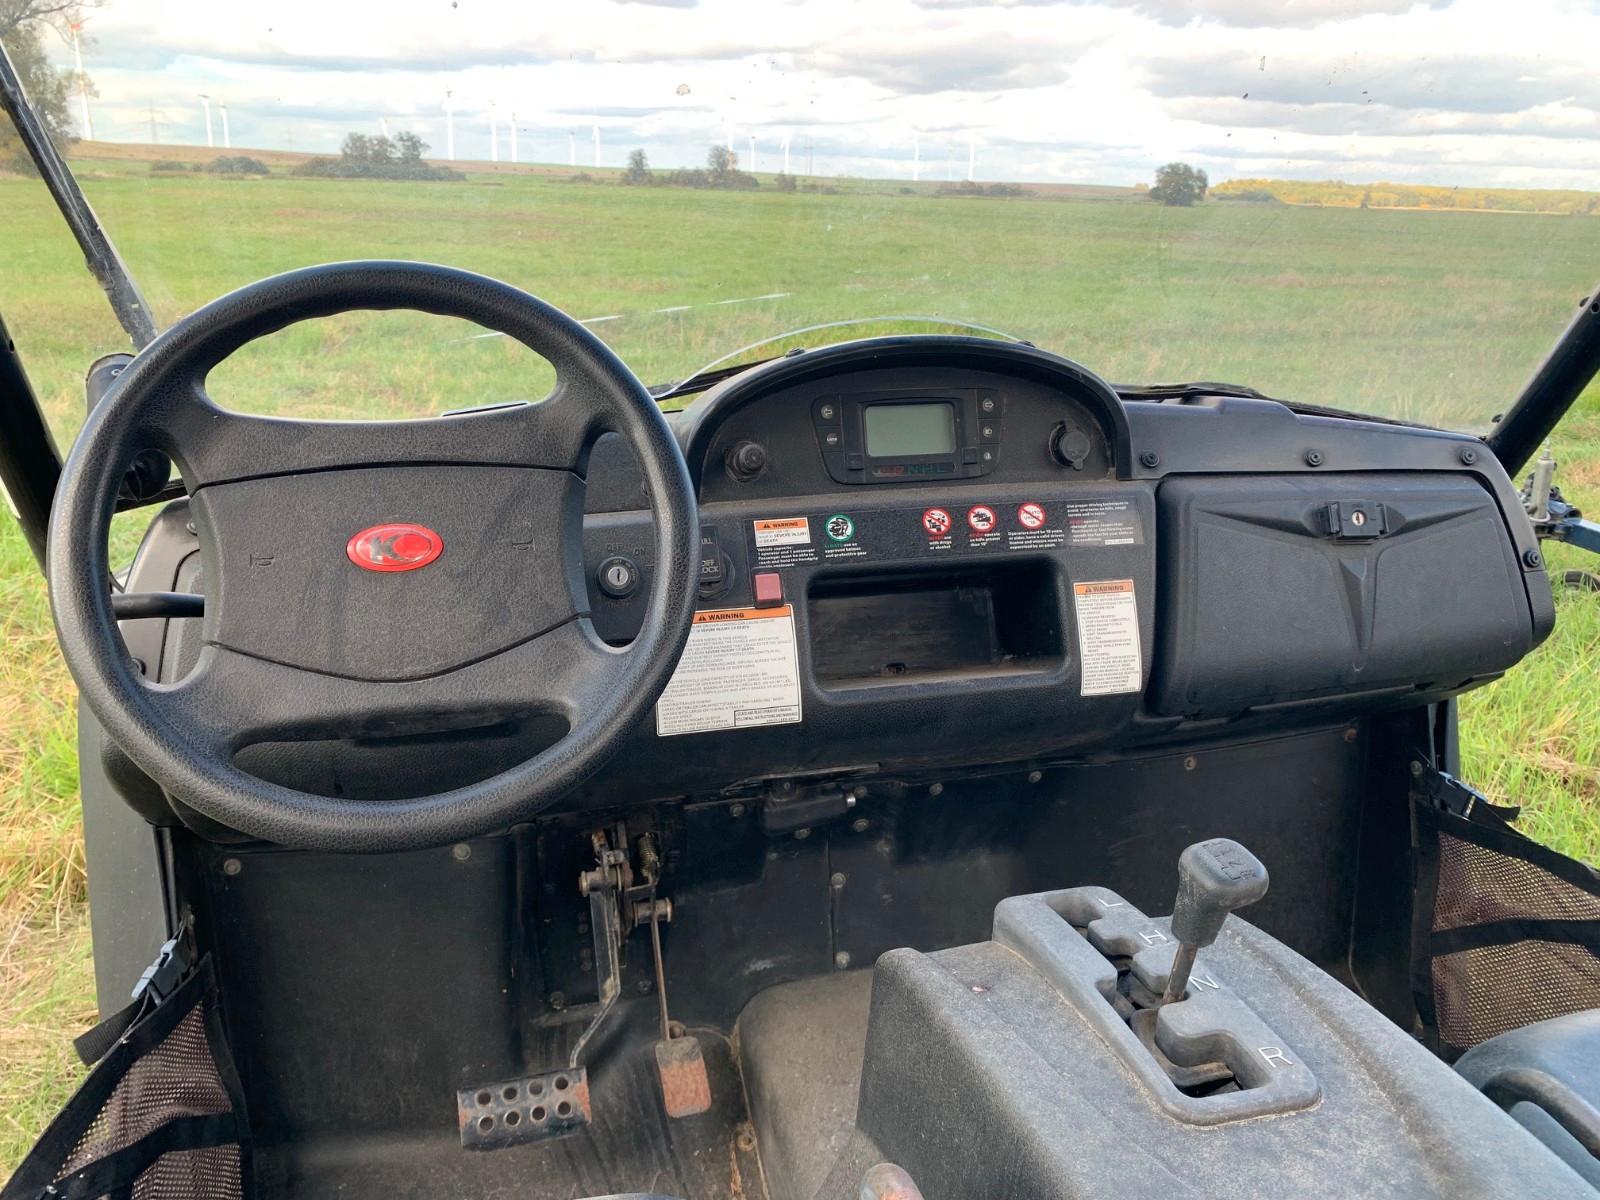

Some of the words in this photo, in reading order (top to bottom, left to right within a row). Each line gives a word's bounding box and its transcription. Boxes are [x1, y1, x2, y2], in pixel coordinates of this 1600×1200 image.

[708, 612, 745, 620] WARNING
[1098, 898, 1124, 907] L
[1138, 929, 1168, 945] H
[1188, 974, 1220, 992] N
[1258, 1046, 1293, 1068] R
